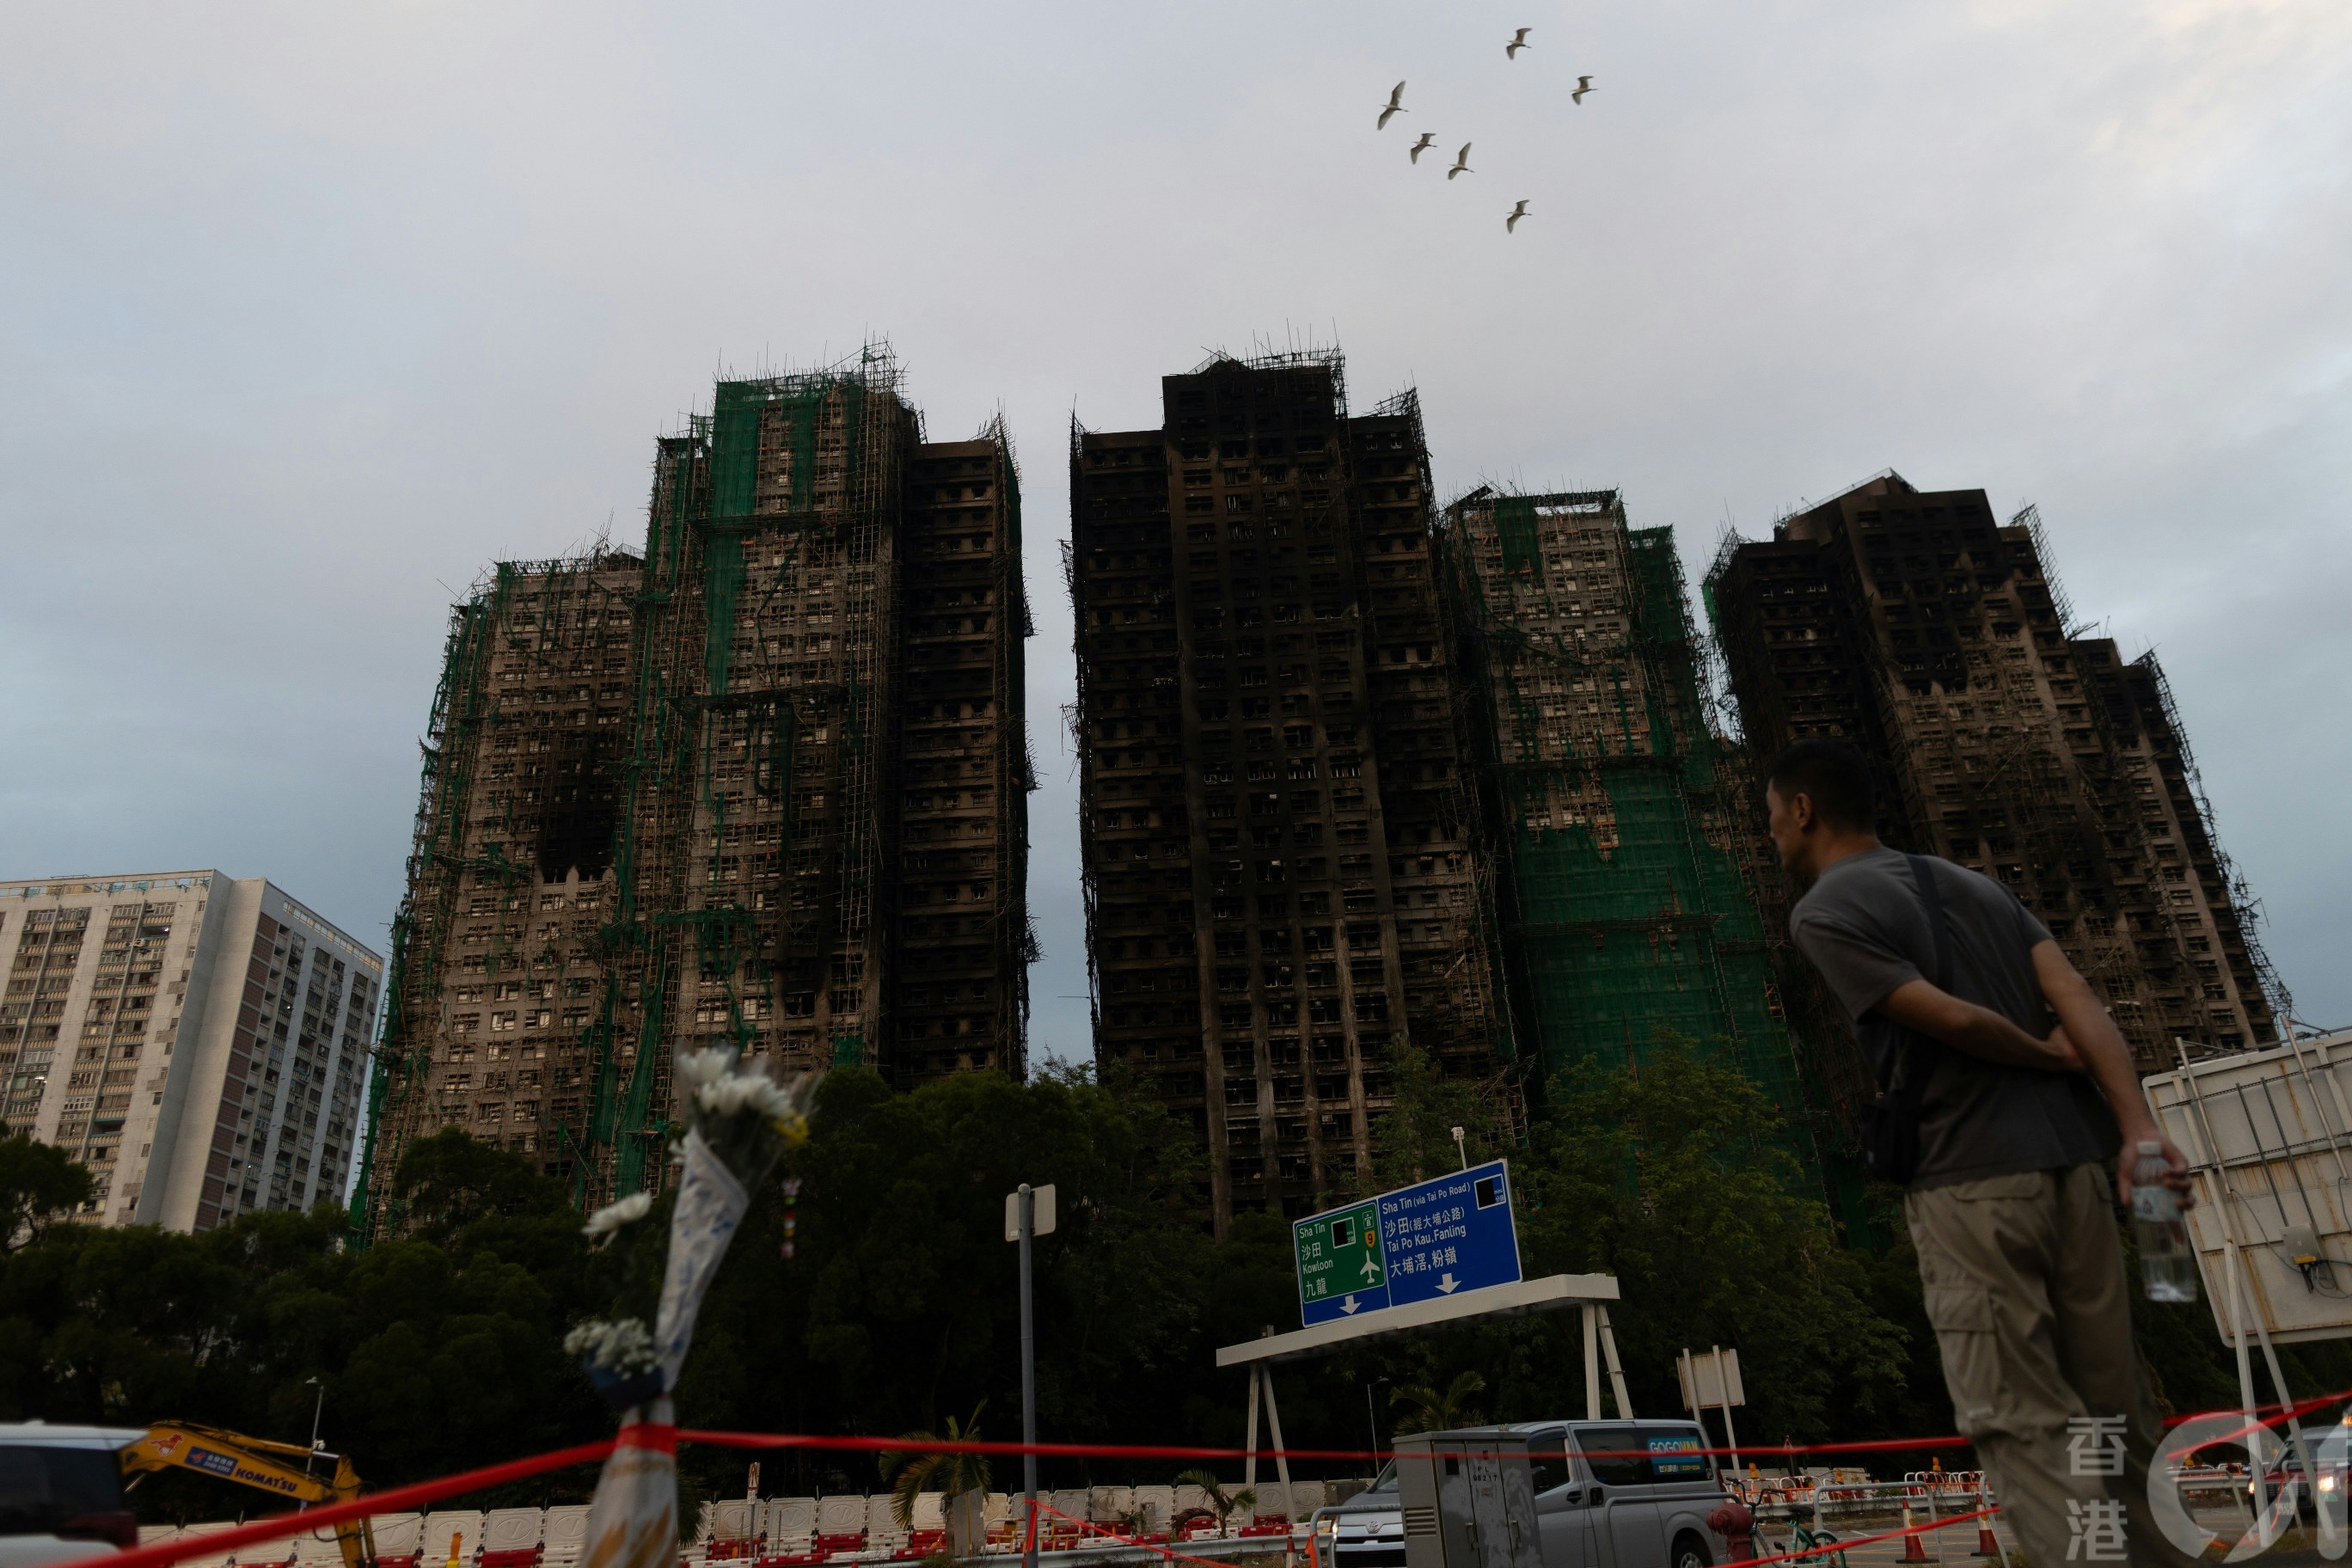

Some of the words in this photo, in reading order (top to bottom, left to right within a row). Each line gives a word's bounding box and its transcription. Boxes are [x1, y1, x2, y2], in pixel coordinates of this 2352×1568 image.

[1382, 1202, 1398, 1215] Sha
[1400, 1197, 1412, 1210] Tin
[1413, 1196, 1426, 1207] (via
[1427, 1191, 1436, 1202] Tai
[1438, 1189, 1448, 1199] Po
[1449, 1182, 1471, 1196] Road)
[1299, 1227, 1313, 1239] Sha
[1314, 1222, 1326, 1234] Tin
[1367, 1233, 1373, 1244] 9
[1302, 1241, 1322, 1261] 沙田
[1387, 1240, 1400, 1253] Tai
[1401, 1237, 1412, 1250] Po
[1302, 1259, 1333, 1275] Kowloon
[1306, 1277, 1327, 1298] 九龍
[236, 1467, 297, 1492] KOMATSU
